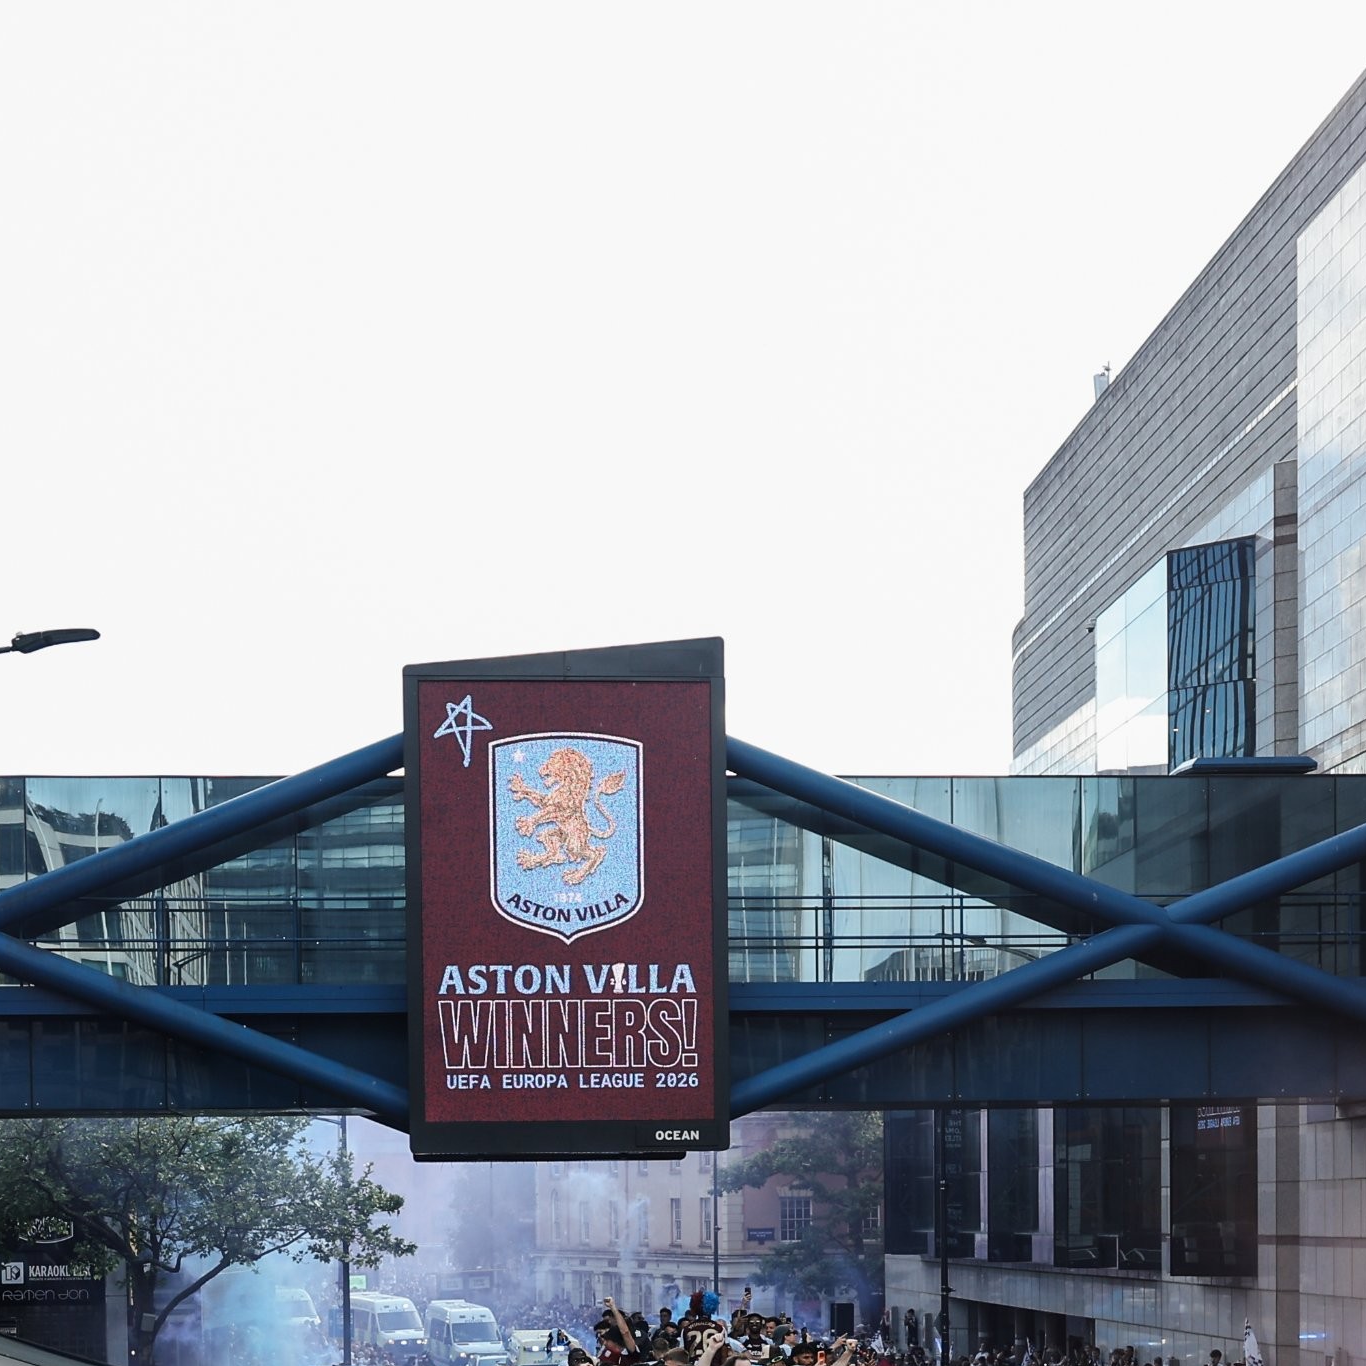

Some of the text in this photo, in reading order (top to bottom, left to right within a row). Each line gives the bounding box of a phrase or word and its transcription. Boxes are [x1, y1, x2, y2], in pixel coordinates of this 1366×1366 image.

[507, 892, 630, 923] ASTON VILLA
[439, 965, 572, 995] ASTON
[439, 999, 697, 1069] WINNERS!
[446, 1072, 698, 1090] UEFA EUROPA LEAGUE 2026
[655, 1130, 699, 1142] OCEAN
